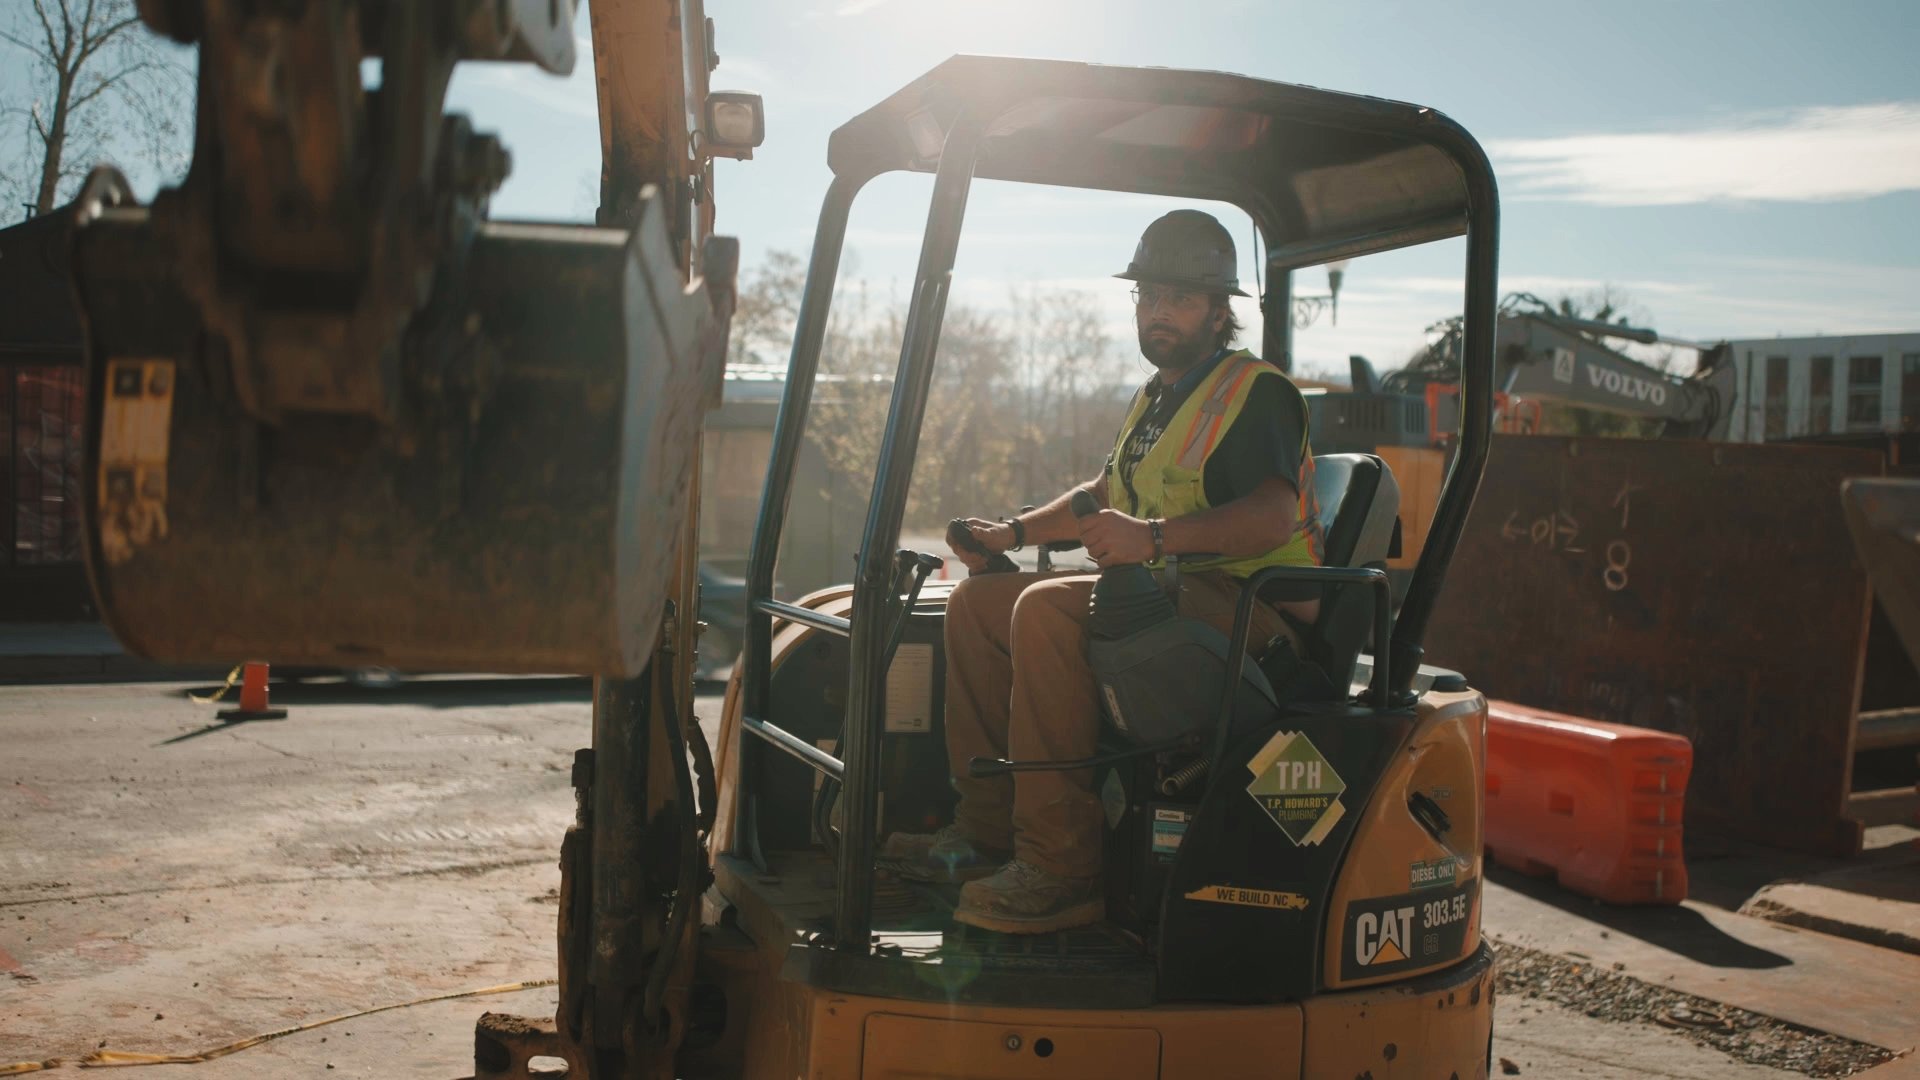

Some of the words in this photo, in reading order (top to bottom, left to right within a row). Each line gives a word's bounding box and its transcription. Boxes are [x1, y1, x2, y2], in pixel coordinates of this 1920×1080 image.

[1586, 363, 1666, 406] VOLVO
[1276, 761, 1321, 790] TPH
[1267, 798, 1282, 809] T.P.
[1285, 797, 1328, 809] HOWARD'S
[1278, 809, 1317, 821] PLUMBING
[1411, 867, 1437, 883] DIESEL
[1438, 862, 1455, 877] ONLY
[1217, 888, 1235, 900] WE
[1238, 890, 1270, 904] BUILD
[1273, 894, 1288, 906] NC
[1424, 894, 1466, 928] 303.5E
[1355, 906, 1415, 966] CAT
